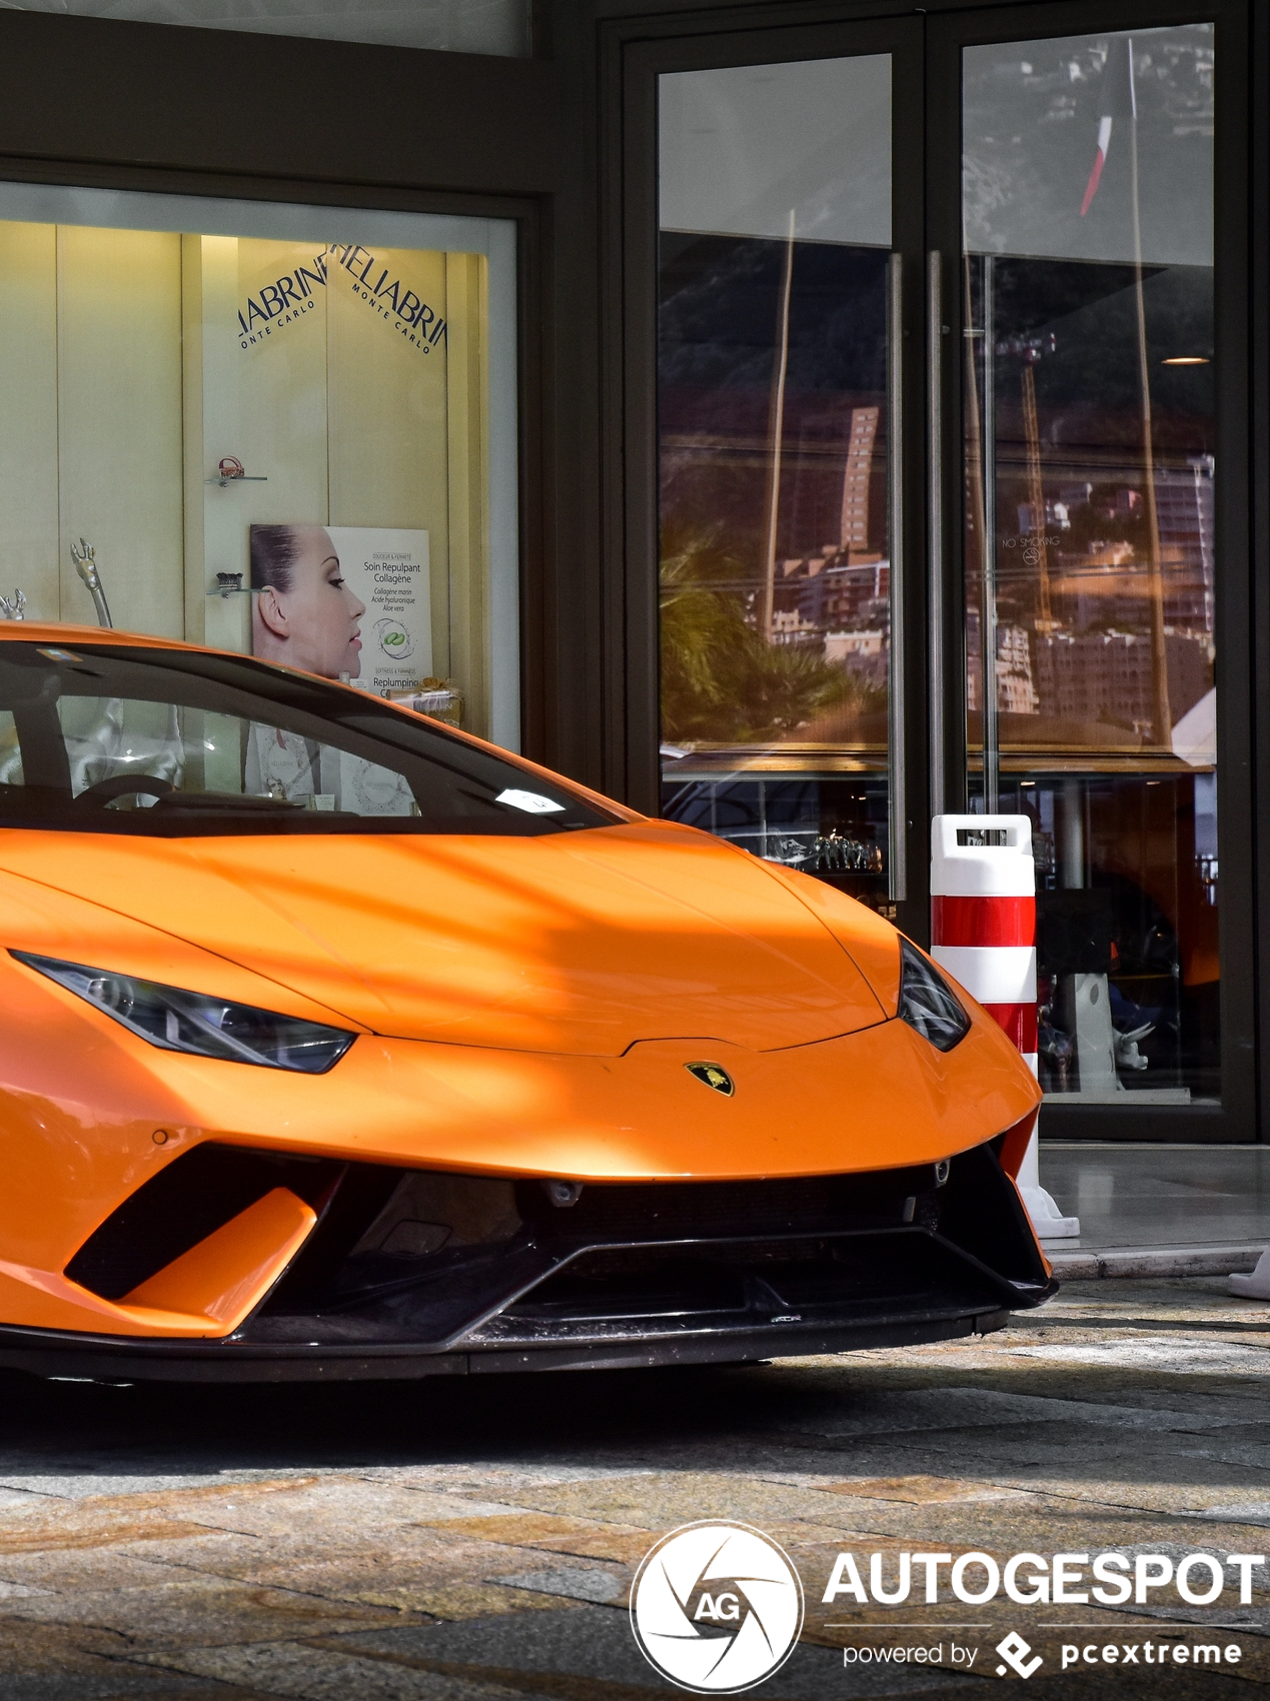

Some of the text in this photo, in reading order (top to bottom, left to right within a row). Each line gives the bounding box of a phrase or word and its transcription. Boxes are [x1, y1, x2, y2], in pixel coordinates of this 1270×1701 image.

[241, 300, 315, 349] ONTE CARLO
[352, 283, 430, 355] MONTE CARLO
[1002, 536, 1061, 548] NO SMOKING
[364, 562, 421, 573] Soin Repulpant
[374, 573, 412, 585] Collagène
